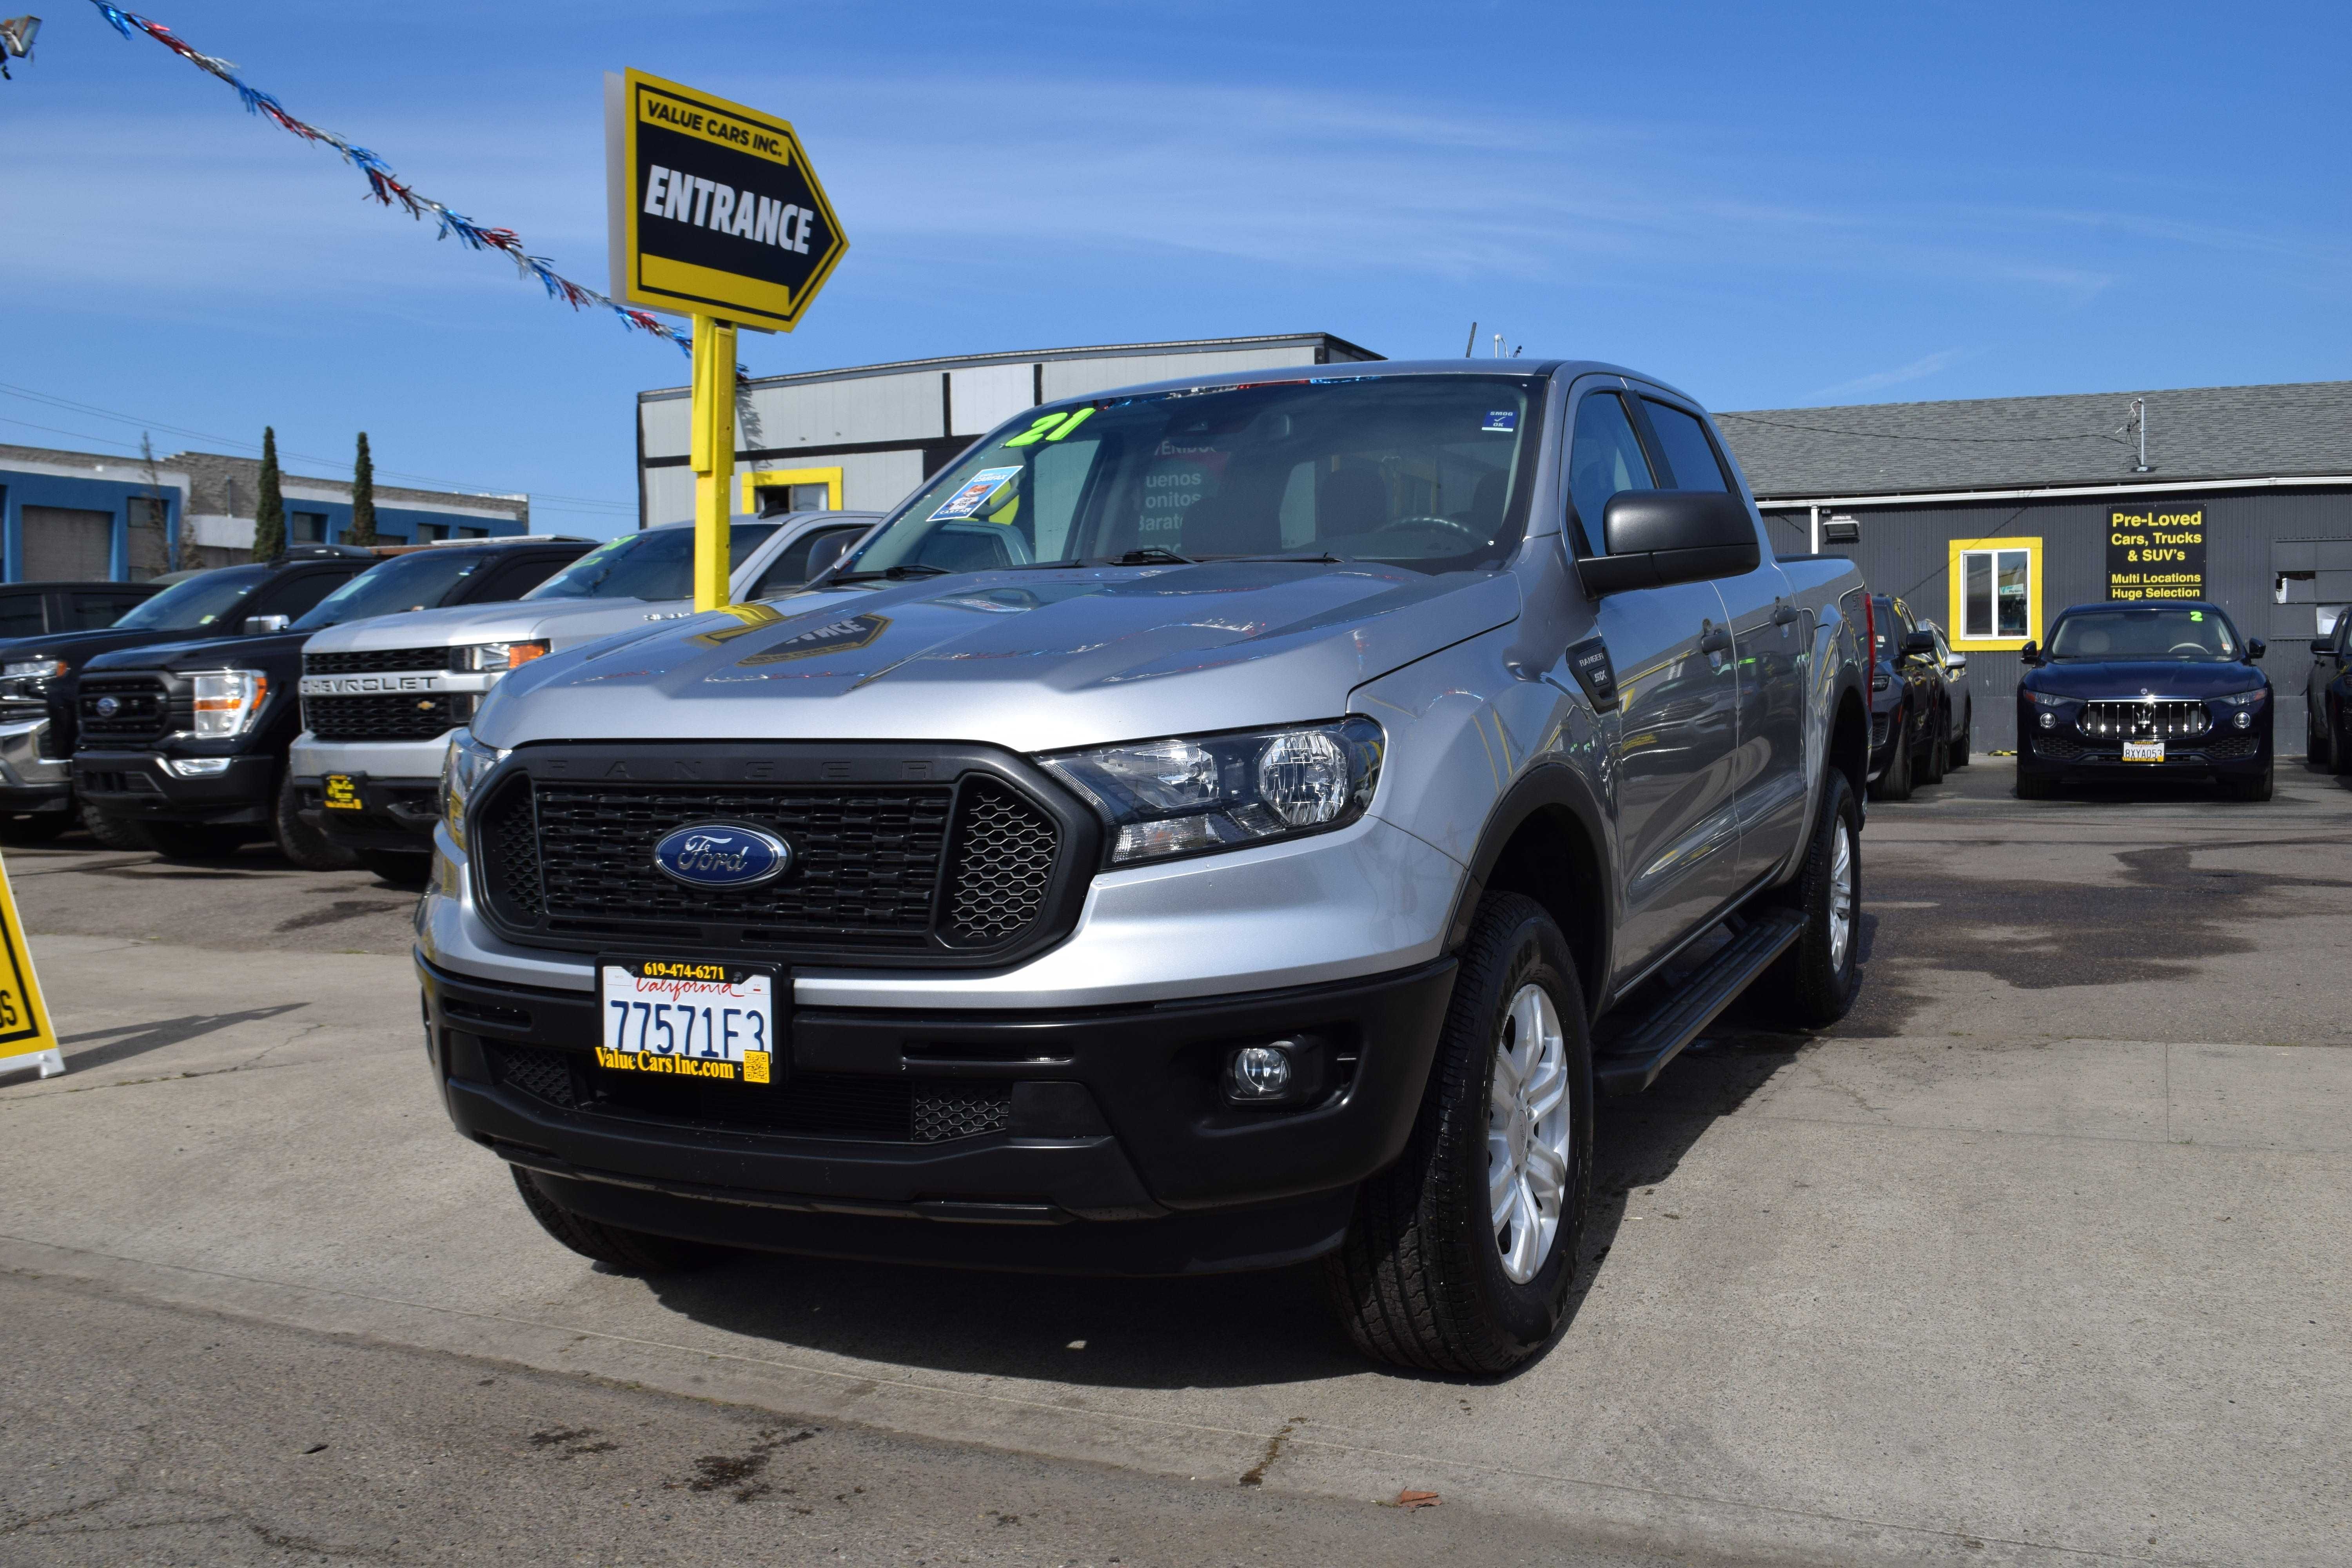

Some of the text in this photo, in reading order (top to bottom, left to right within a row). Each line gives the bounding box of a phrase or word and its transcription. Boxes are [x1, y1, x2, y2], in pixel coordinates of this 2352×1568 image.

[648, 100, 782, 157] VALUE CARS INC.
[644, 165, 813, 255] ENTRANCE
[1005, 408, 1096, 447] 21
[1146, 473, 1201, 487] uenos
[1145, 492, 1202, 508] onitos
[2112, 511, 2201, 527] Pre-Loved
[2112, 532, 2202, 546] Cars, Trucks
[2128, 549, 2185, 561] & SUV's
[2112, 573, 2201, 584] Multi Locations
[2112, 588, 2200, 600] Huge Selection
[2190, 612, 2203, 621] 2
[1579, 653, 1604, 666] RANGER
[1594, 670, 1607, 682] STX
[301, 677, 438, 693] CHEVROLET
[2125, 749, 2162, 758] 8XYA053
[678, 835, 750, 872] Ford
[644, 962, 725, 980] 619-474-6271
[636, 978, 745, 1002] California
[0, 990, 17, 1028] S
[611, 1000, 764, 1058] 77571F3
